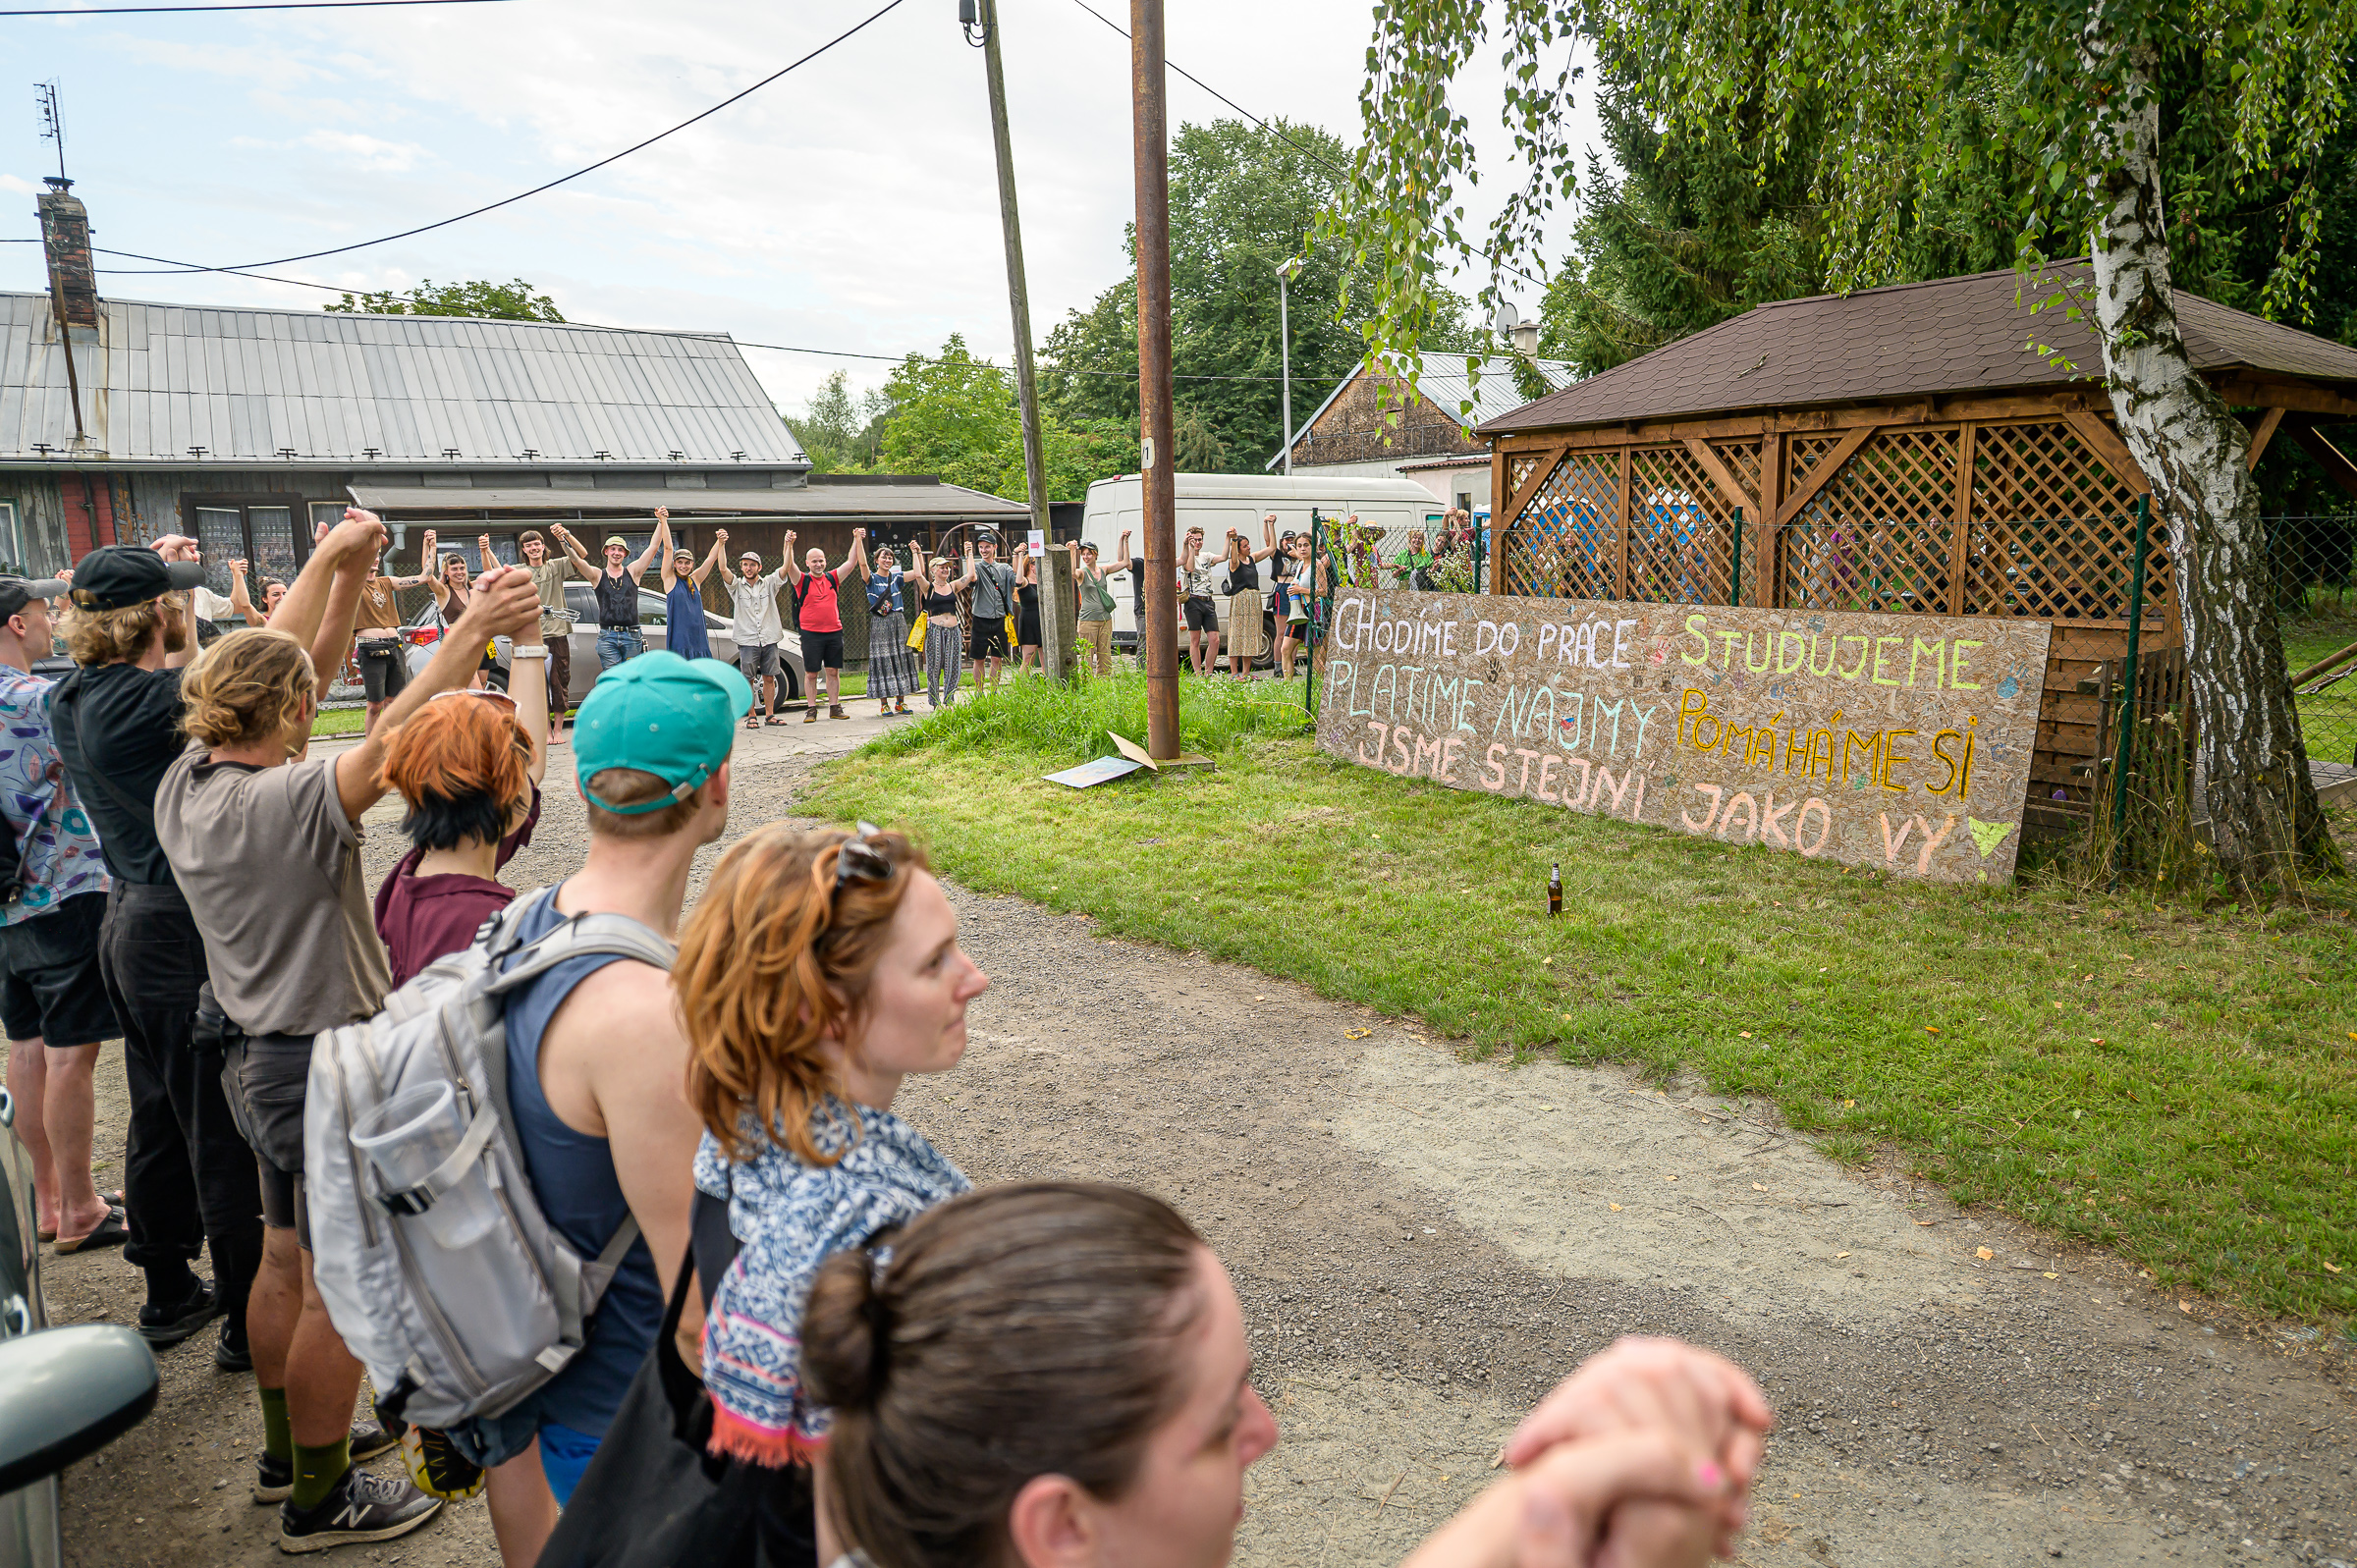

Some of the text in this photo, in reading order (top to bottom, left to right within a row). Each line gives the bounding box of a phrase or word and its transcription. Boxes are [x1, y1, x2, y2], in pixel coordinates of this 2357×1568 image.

[1475, 620, 1520, 657] DO
[1538, 611, 1638, 670] PRÁCE
[1680, 615, 1984, 690] STUDUJEME
[1493, 671, 1658, 759] NÁJMY
[1677, 688, 1918, 793] POMÁHÁME
[1358, 721, 1463, 784] JSME
[1681, 783, 1832, 857] JAKO
